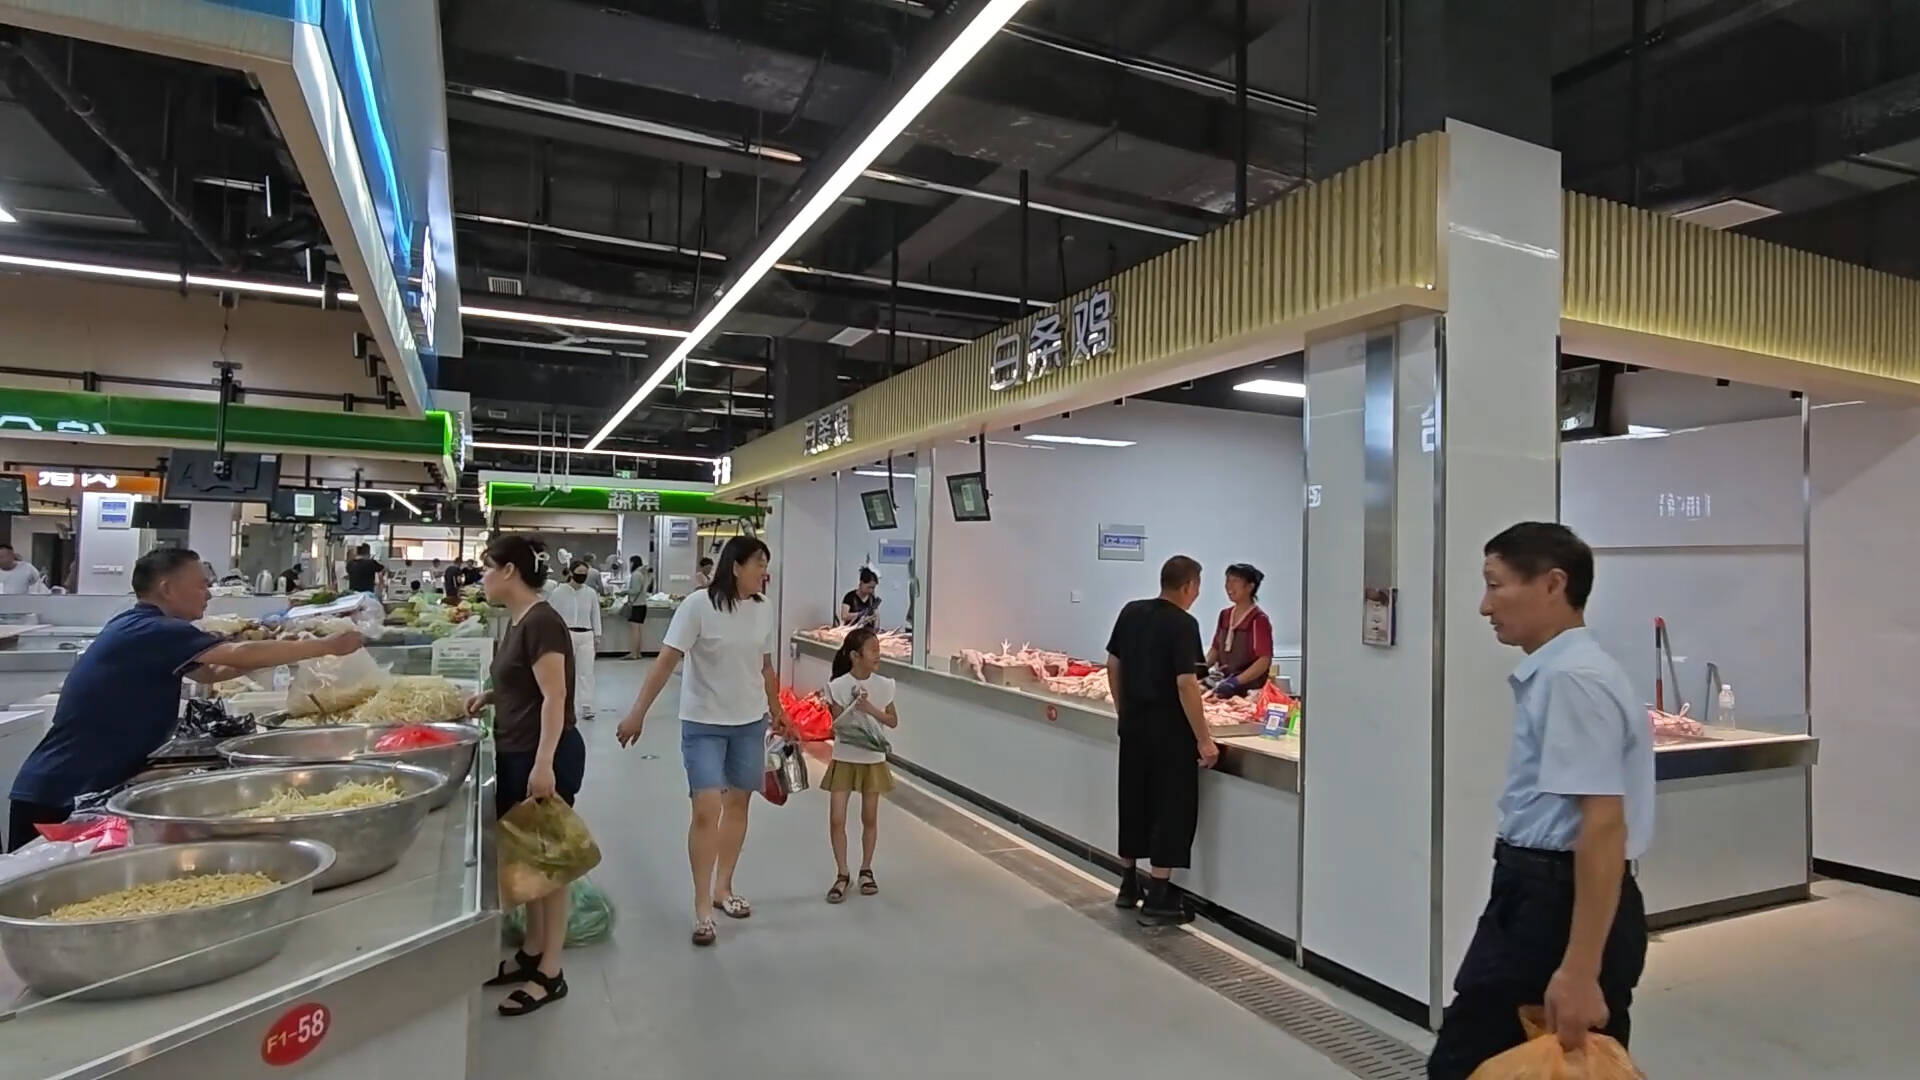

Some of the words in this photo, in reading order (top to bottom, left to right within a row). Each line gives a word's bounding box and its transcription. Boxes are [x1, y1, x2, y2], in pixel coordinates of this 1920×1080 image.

[990, 290, 1112, 391] 白条鸡
[267, 1009, 324, 1054] F1-58
